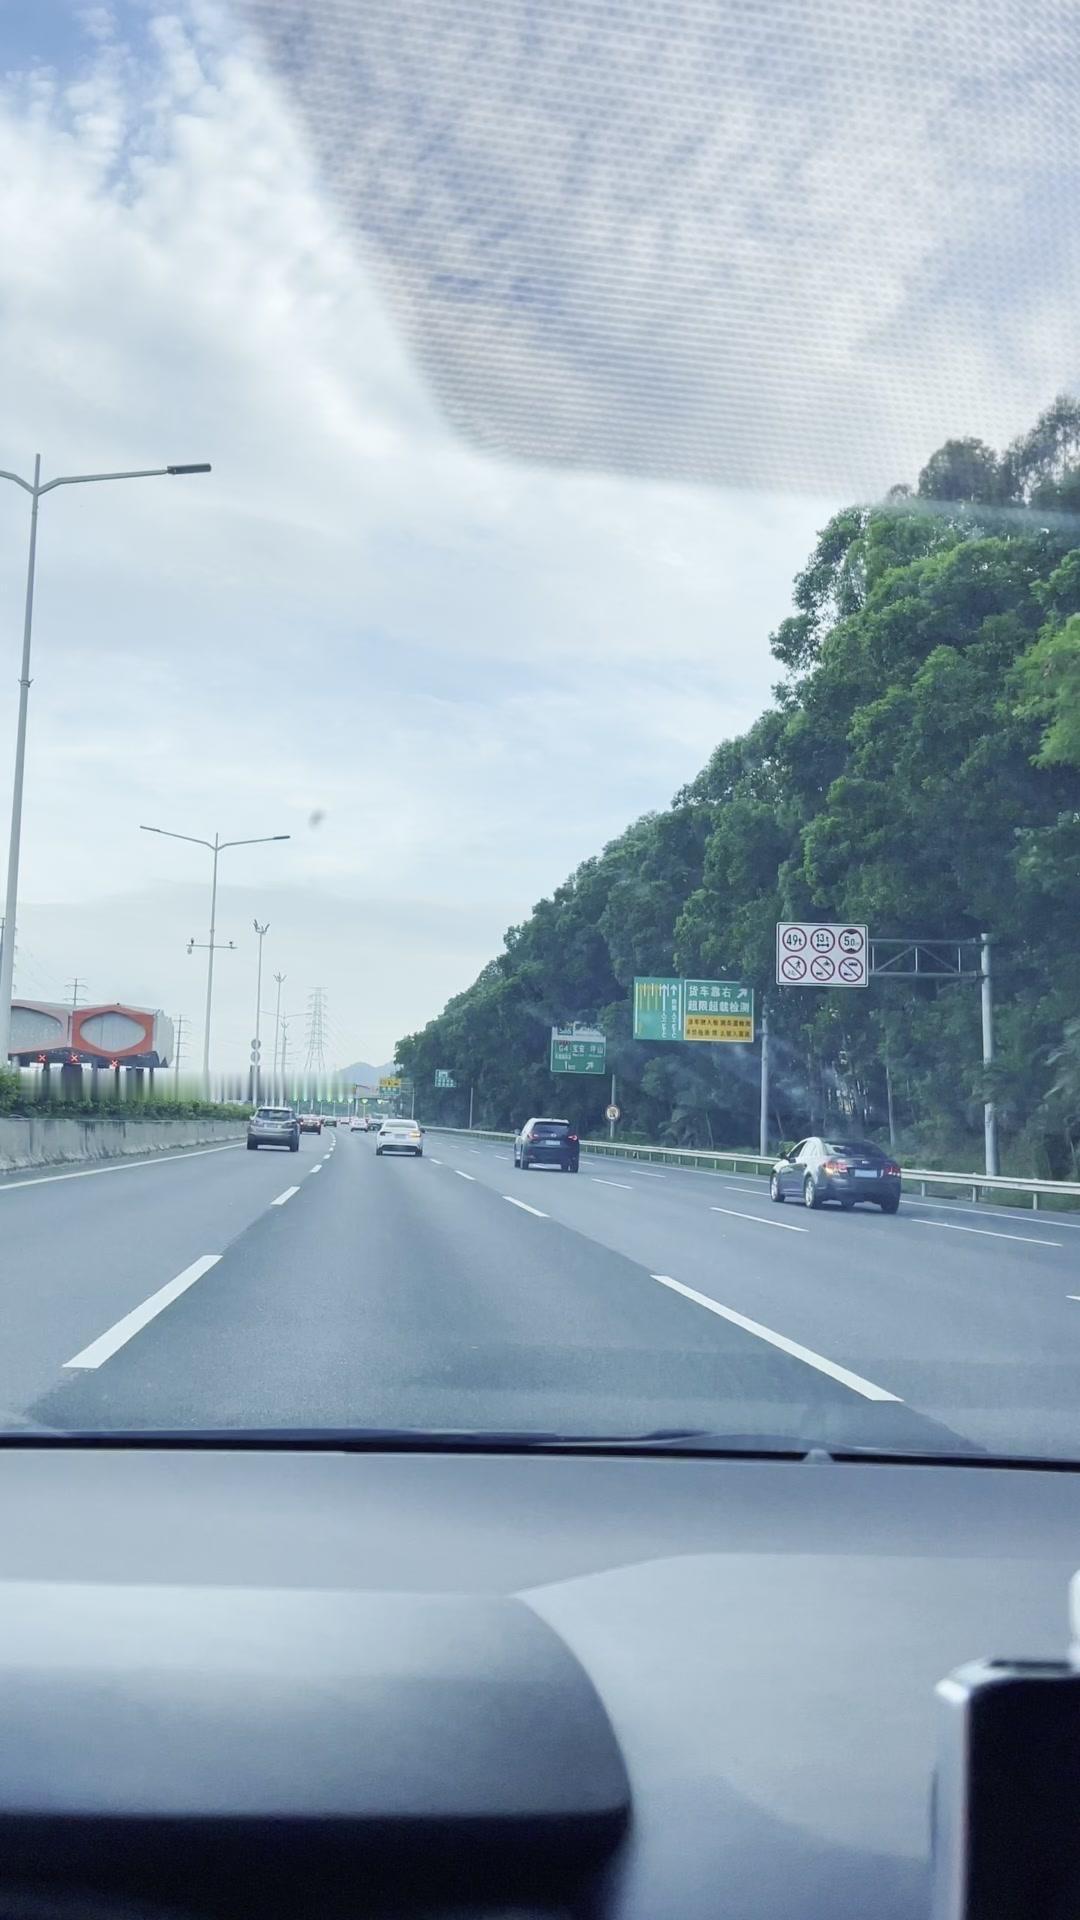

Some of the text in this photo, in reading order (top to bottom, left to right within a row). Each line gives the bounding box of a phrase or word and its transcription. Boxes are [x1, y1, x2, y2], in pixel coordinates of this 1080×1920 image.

[786, 934, 802, 946] 49t
[815, 933, 829, 943] 13t
[688, 985, 732, 998] 货车靠右
[687, 1000, 750, 1013] 超限超载检测
